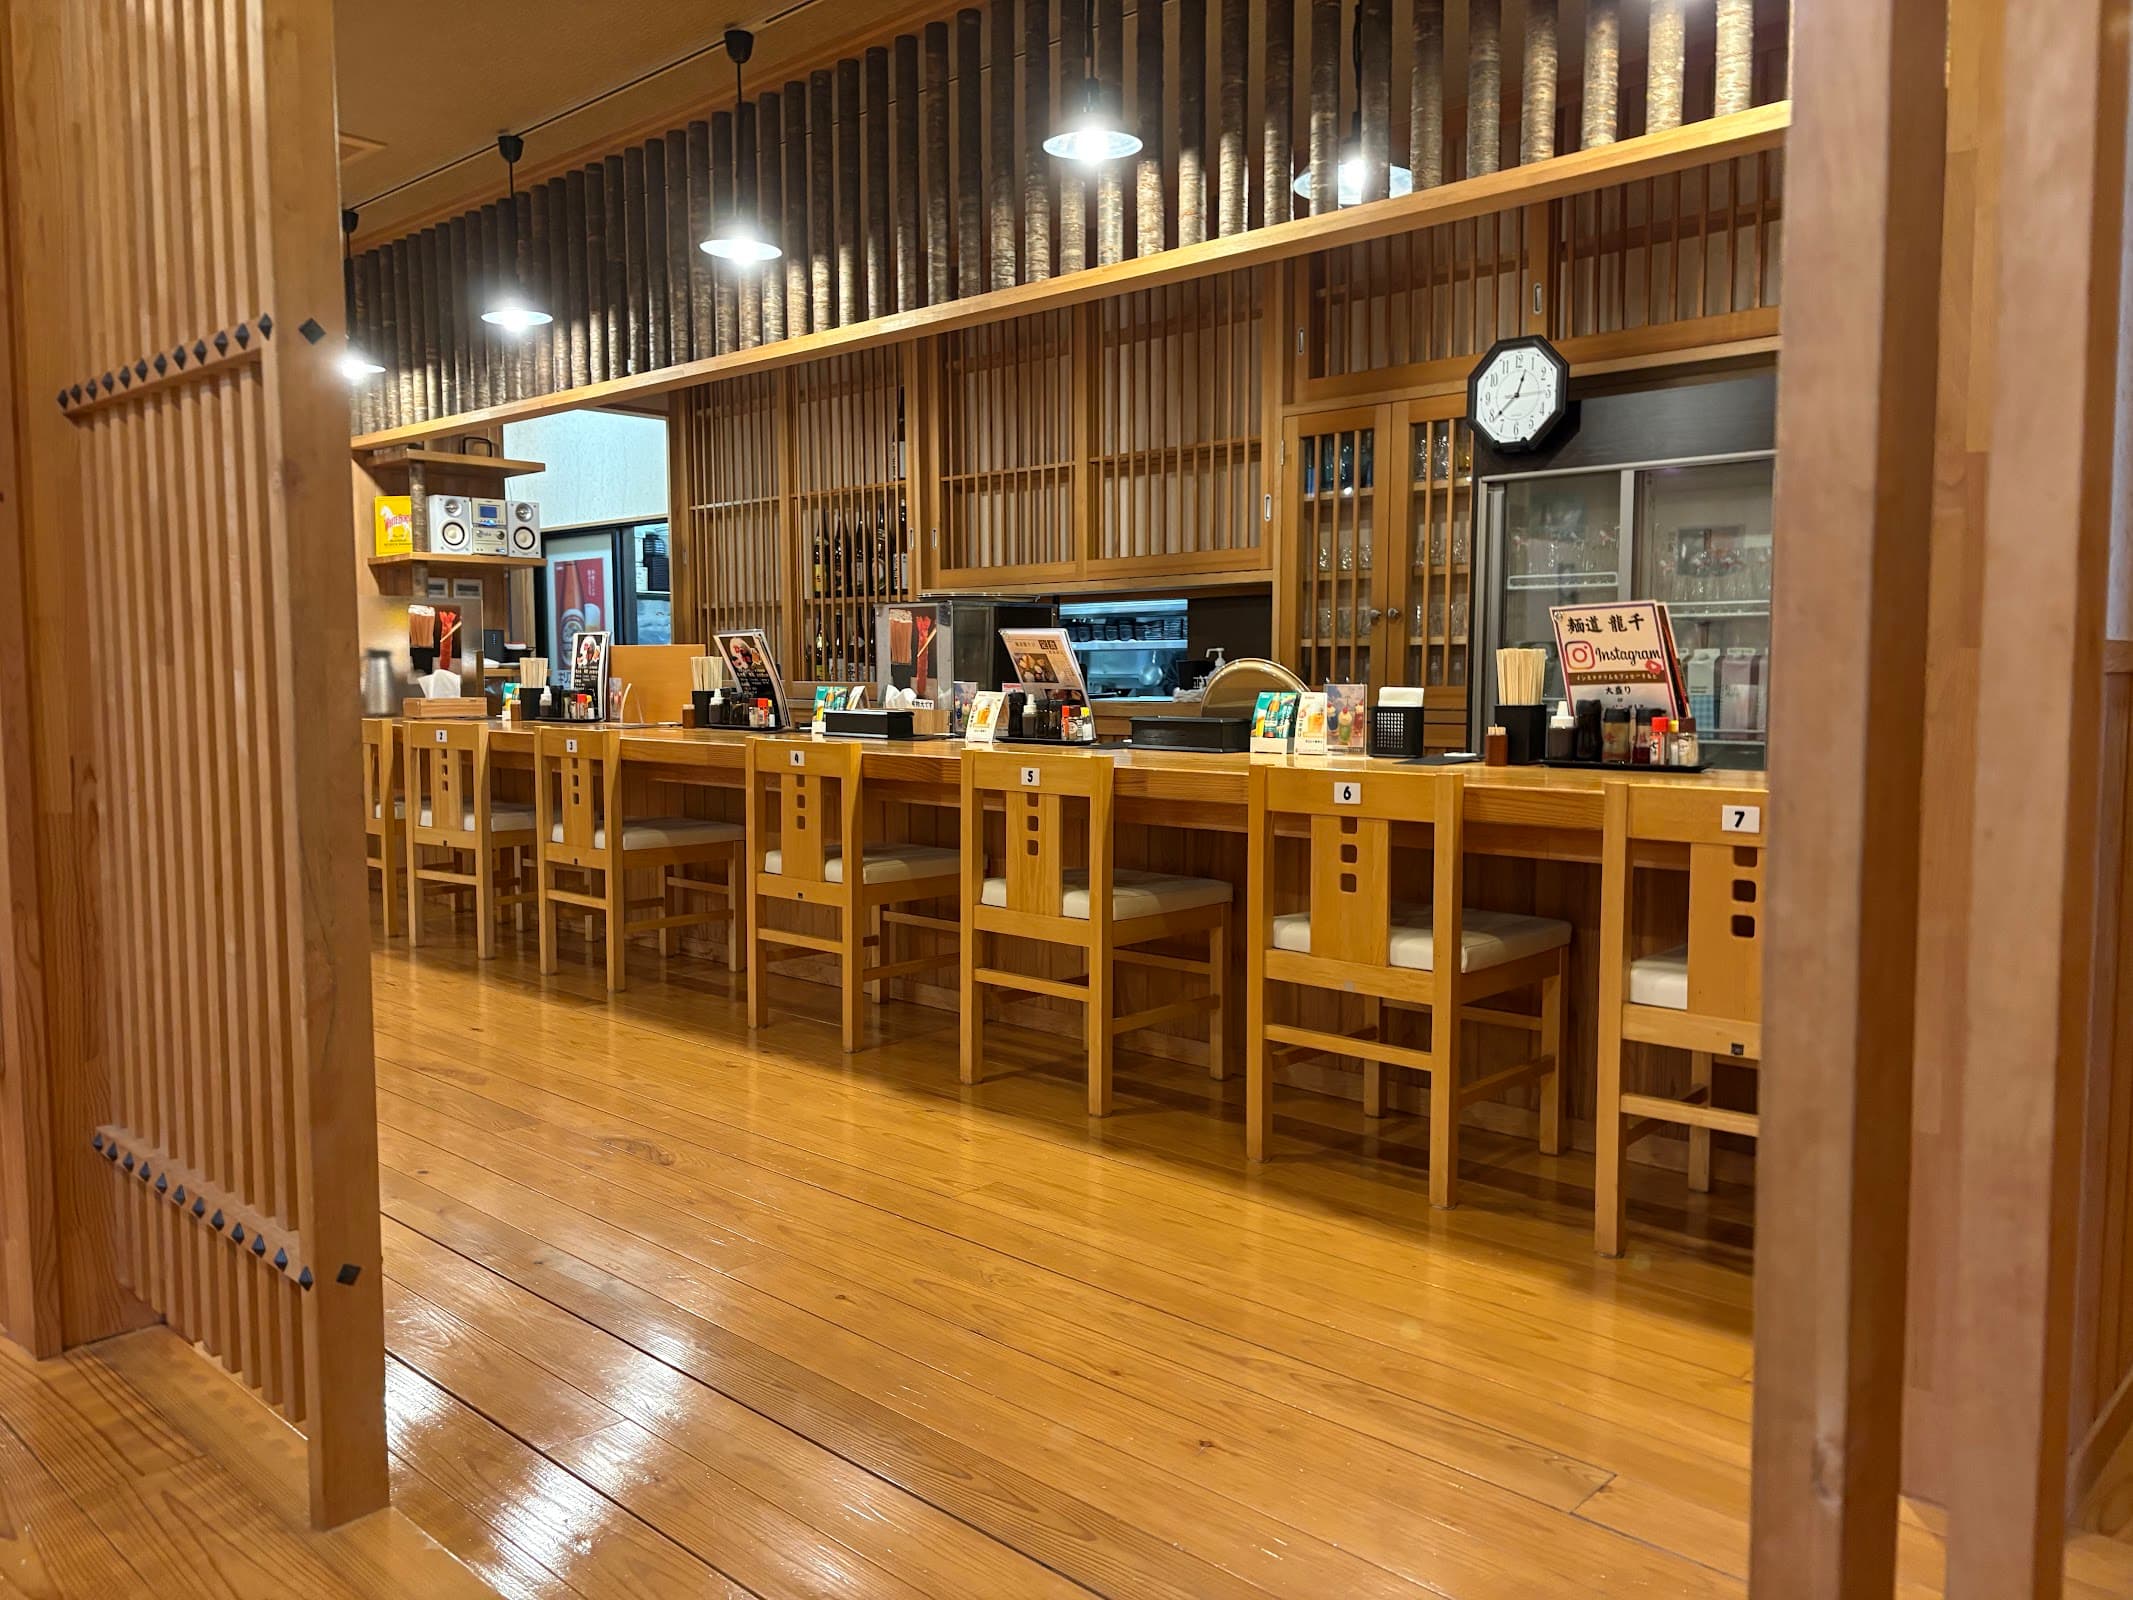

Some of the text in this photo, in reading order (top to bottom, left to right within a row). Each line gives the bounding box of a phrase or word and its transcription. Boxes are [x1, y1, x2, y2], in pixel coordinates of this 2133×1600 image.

[1502, 360, 1509, 375] 11
[1515, 354, 1524, 368] 12
[1531, 356, 1535, 370] 1
[1490, 371, 1498, 387] 10
[1595, 646, 1662, 666] Instagram
[794, 752, 799, 765] 4
[1027, 770, 1034, 783] 5
[1343, 785, 1352, 801] 6
[1734, 810, 1745, 828] 7
